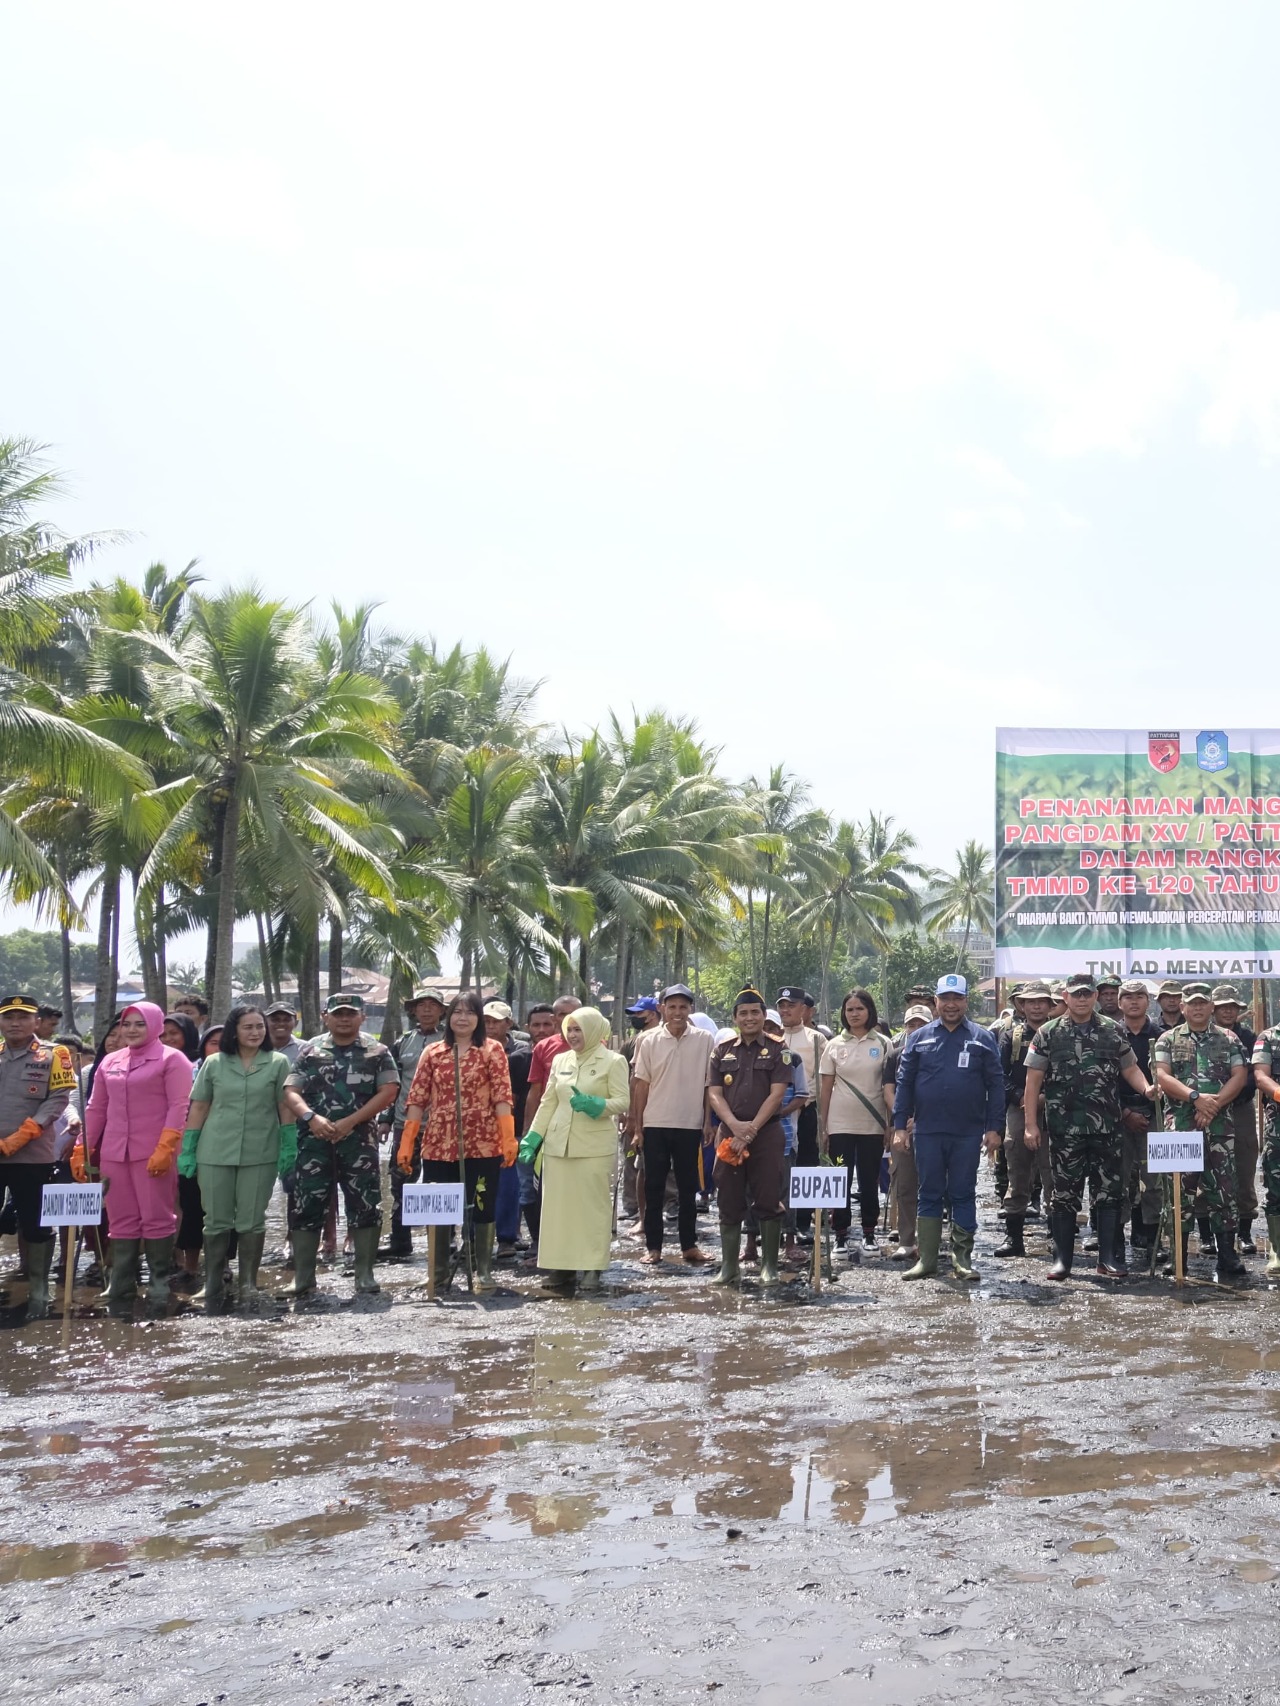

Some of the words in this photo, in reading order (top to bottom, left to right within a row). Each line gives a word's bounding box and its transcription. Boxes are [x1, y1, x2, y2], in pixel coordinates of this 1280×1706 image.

[1020, 797, 1194, 818] PENANAMAN
[1005, 823, 1142, 844] PANGDAM
[1150, 823, 1189, 842] XV
[1196, 822, 1205, 843] /
[1080, 850, 1176, 870] DALAM
[1006, 876, 1090, 896] TMMD
[1099, 876, 1136, 895] KE
[1146, 875, 1194, 895] 120
[1017, 912, 1057, 925] DHARMA
[1059, 912, 1085, 925] BAKTI
[1087, 911, 1117, 924] TMMD
[1120, 911, 1185, 924] MEWUJUDKAN
[1187, 910, 1244, 924] PERCEPATAN
[1086, 960, 1122, 975] TNI
[1129, 960, 1159, 974] AD
[1167, 959, 1272, 974] MENYATU
[1149, 1144, 1169, 1159] PANGDAM
[791, 1176, 846, 1198] BUPATI
[43, 1194, 64, 1216] DANDIM
[404, 1195, 419, 1213] KETUA
[444, 1194, 459, 1213] HALUT
